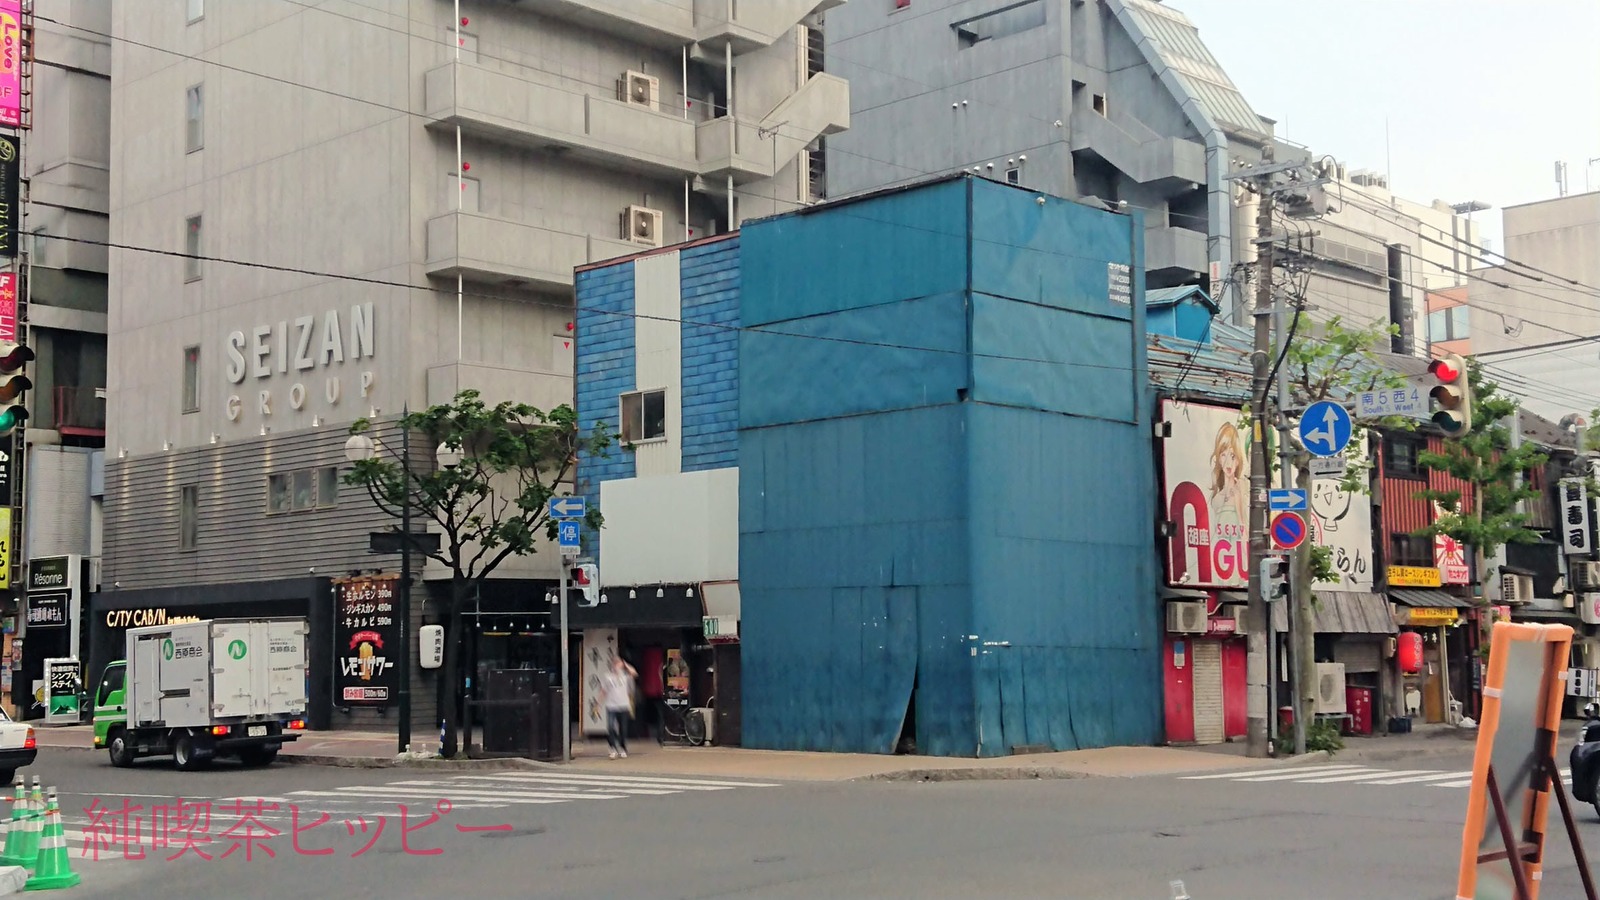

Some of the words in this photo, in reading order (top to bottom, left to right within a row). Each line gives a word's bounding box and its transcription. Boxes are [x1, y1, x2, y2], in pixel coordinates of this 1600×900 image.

[4, 23, 16, 69] Love
[226, 302, 375, 384] SEIZAN
[226, 371, 375, 421] GROUP
[1363, 406, 1384, 414] South
[1395, 403, 1414, 411] West
[561, 525, 577, 541] 停
[1188, 526, 1209, 546] 胡座
[1217, 523, 1245, 537] SEXY
[34, 573, 63, 585] Résonne
[704, 618, 718, 635] 500
[340, 655, 394, 677] レモンサワー
